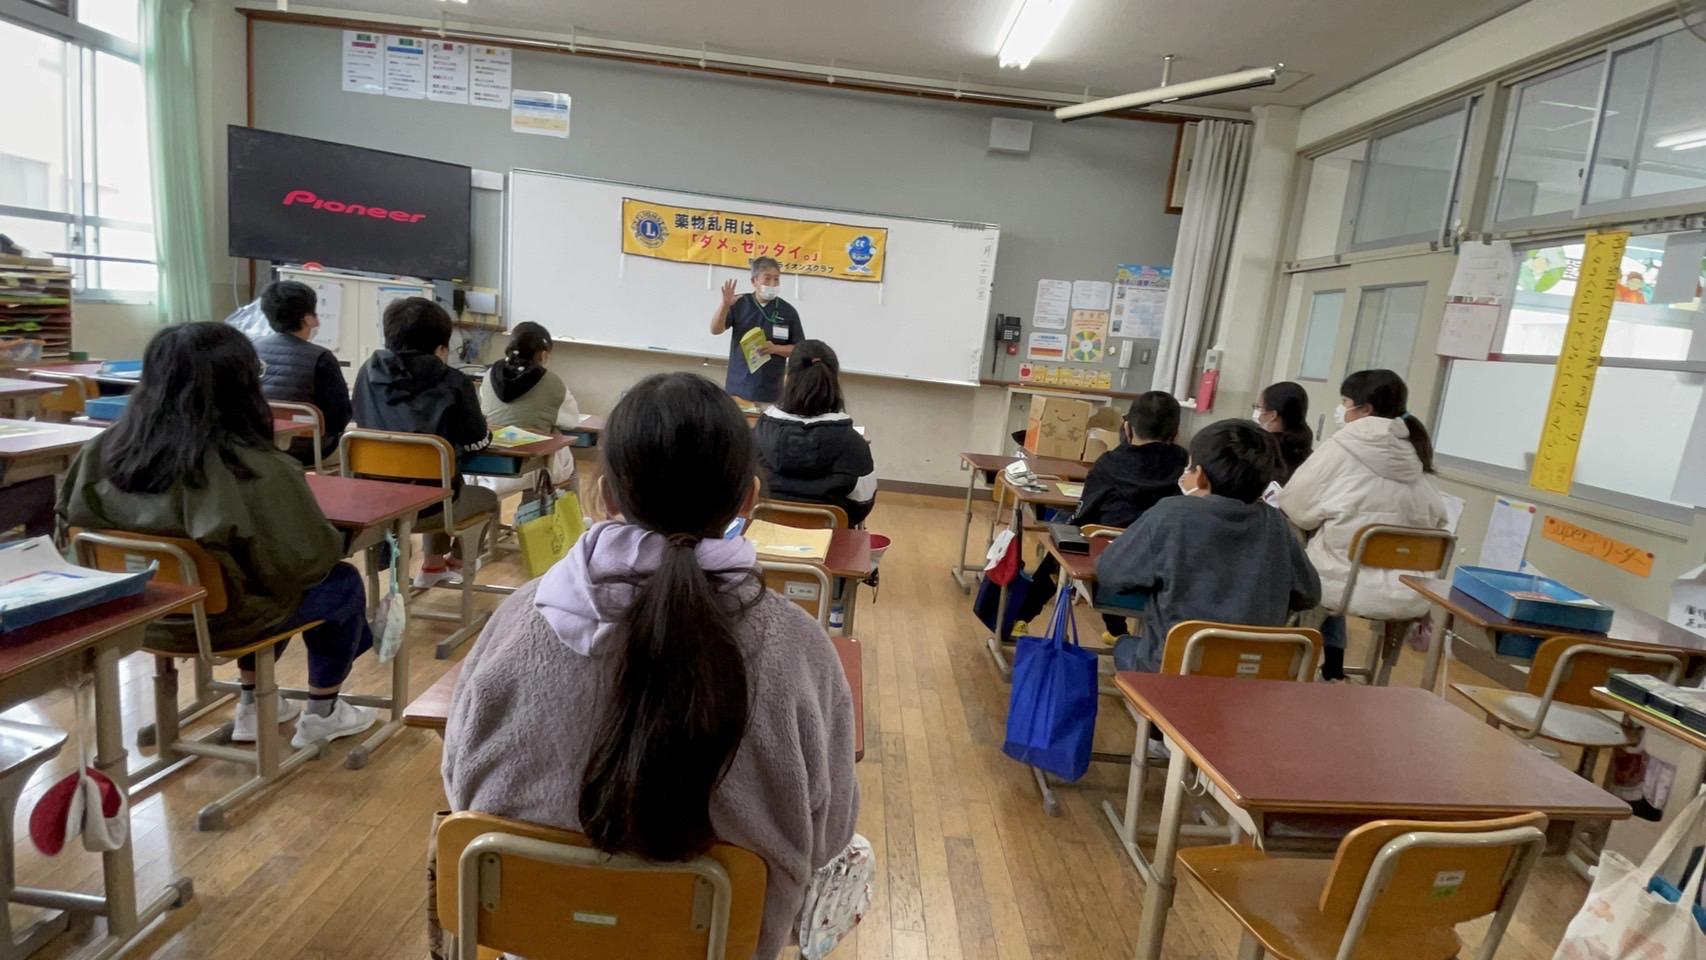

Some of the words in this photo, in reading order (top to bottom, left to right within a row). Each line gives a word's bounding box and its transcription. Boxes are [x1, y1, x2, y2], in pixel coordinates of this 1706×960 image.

[282, 190, 426, 223] Pioneer
[674, 213, 761, 236] 薬物乱用は、
[691, 234, 818, 261] 「ダメ。ゼッタイ。」
